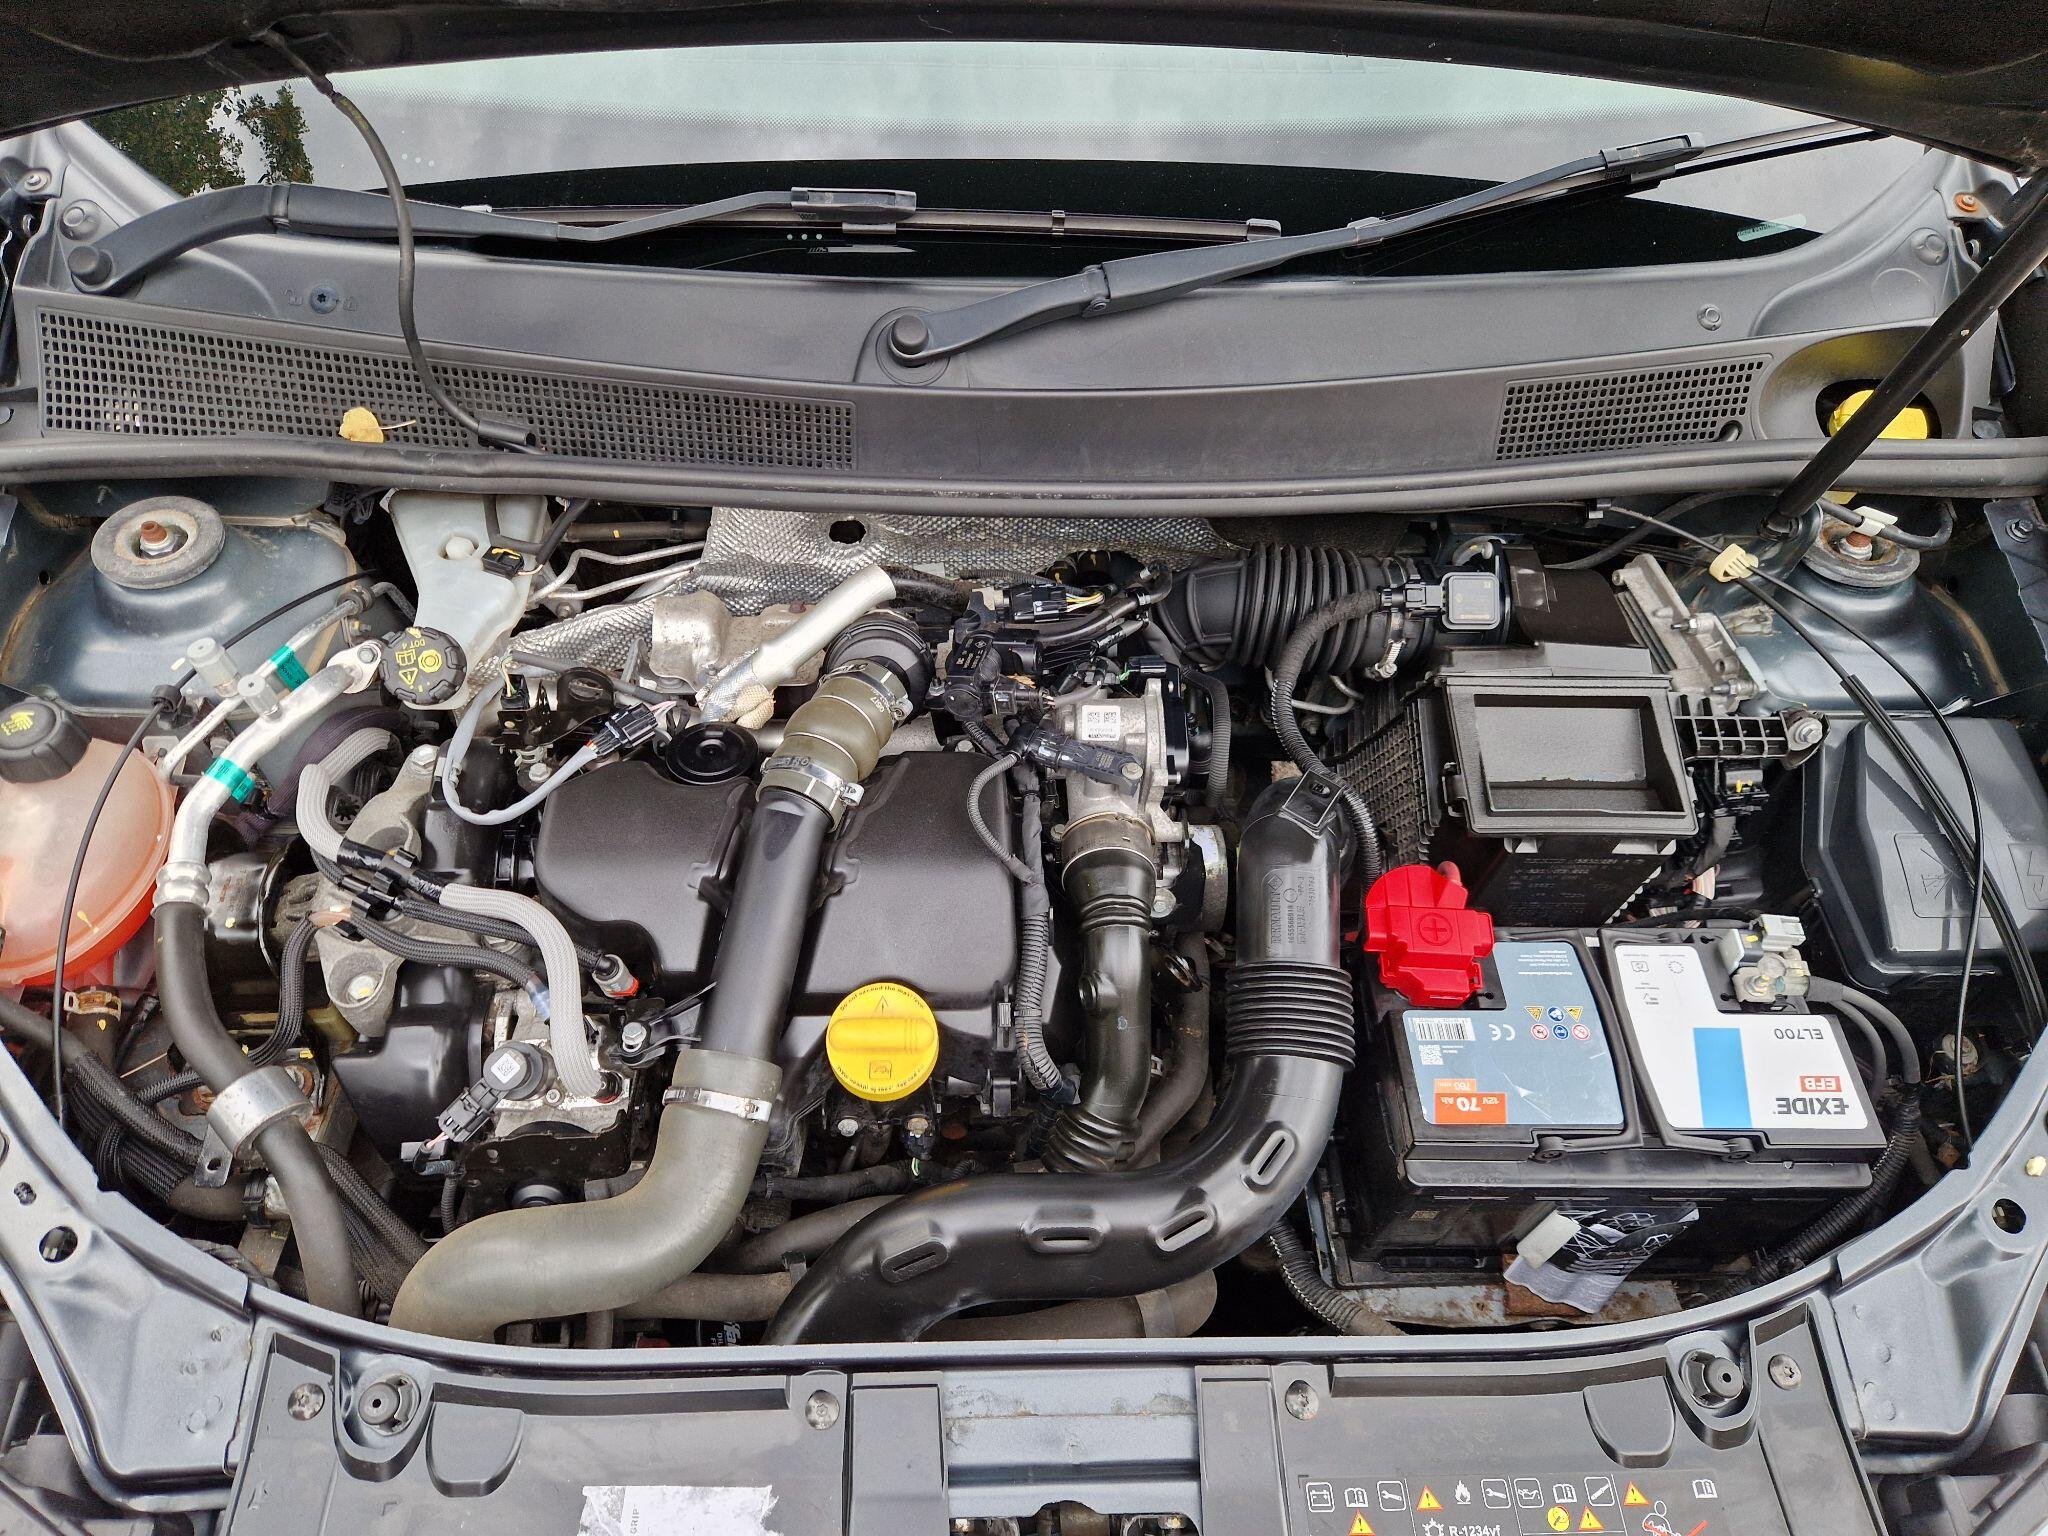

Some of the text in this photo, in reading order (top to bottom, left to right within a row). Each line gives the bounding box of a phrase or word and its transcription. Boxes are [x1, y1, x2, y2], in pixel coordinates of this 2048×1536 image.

[410, 638, 426, 649] DOT
[1774, 1028, 1824, 1040] EL700
[1804, 1077, 1837, 1090] EFB
[1440, 1097, 1500, 1112] 12V 70 Ah
[1776, 1098, 1849, 1115] EXIDE
